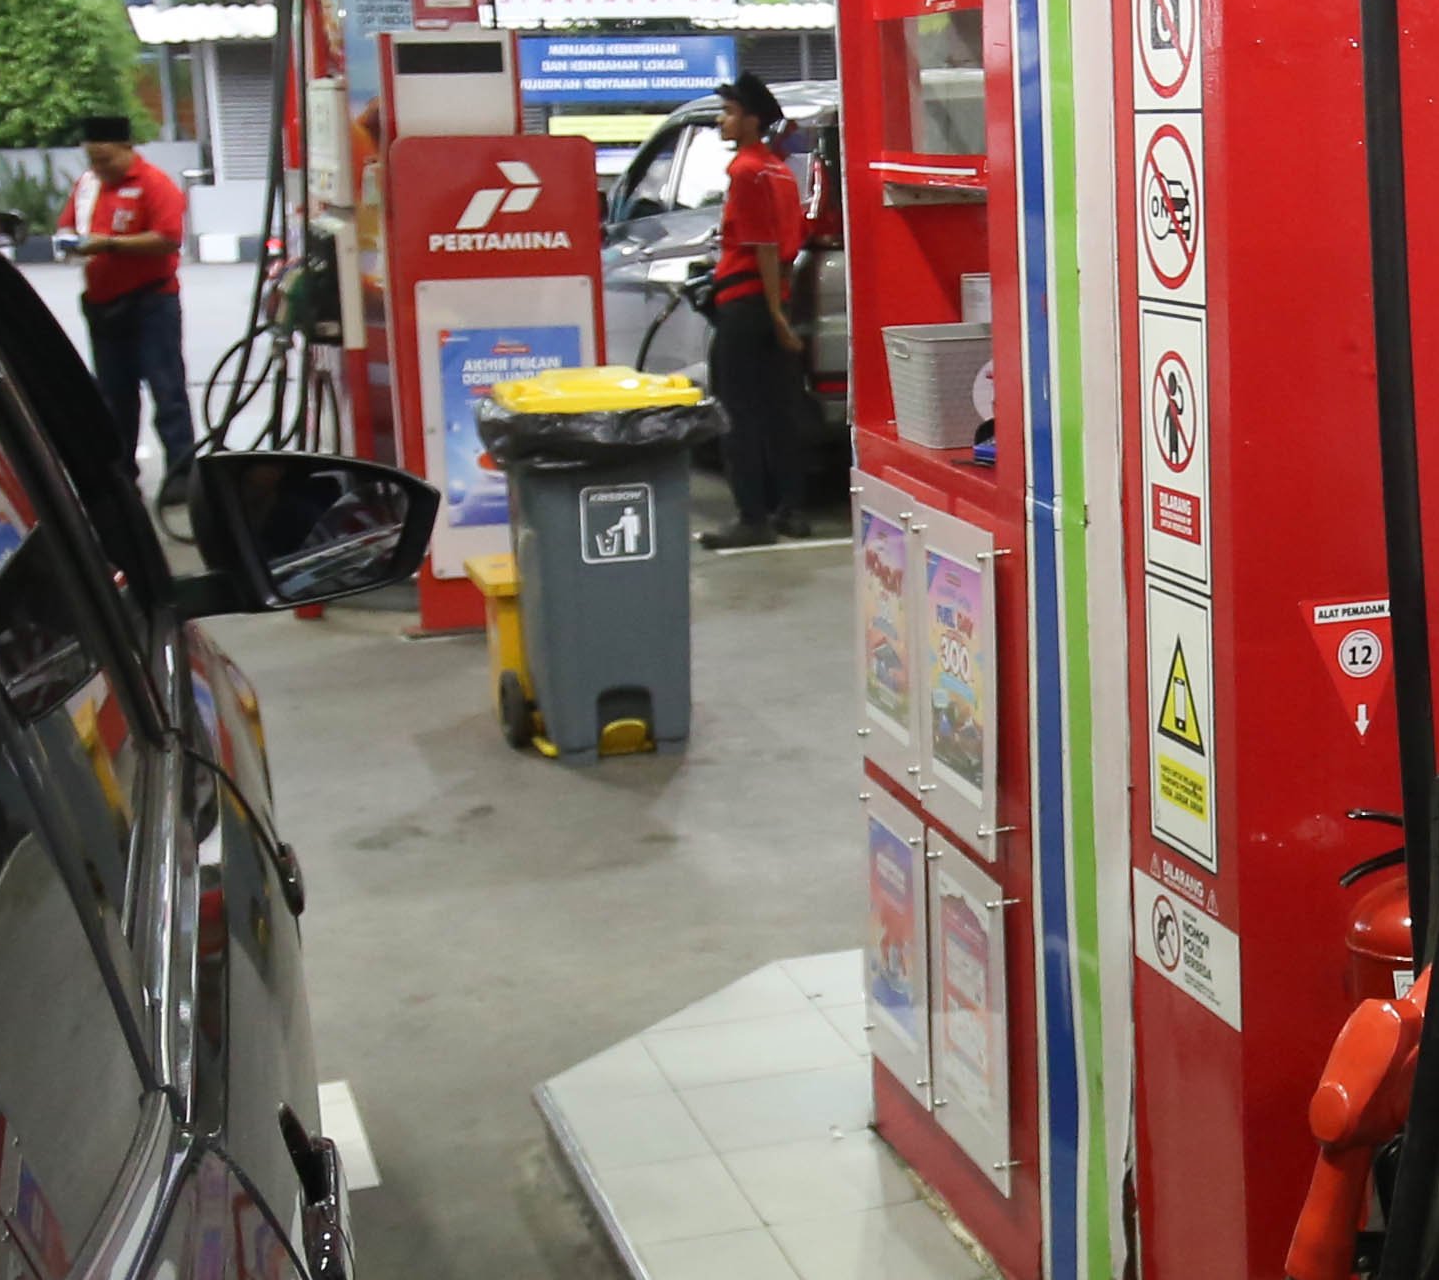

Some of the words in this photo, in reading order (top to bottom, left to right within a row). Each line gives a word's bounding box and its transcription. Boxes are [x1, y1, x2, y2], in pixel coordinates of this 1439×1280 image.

[429, 231, 571, 253] PERTAMINA
[1318, 608, 1339, 620] ALAT
[1341, 604, 1385, 618] PEMADAM
[940, 635, 971, 684] 300
[1348, 644, 1373, 666] 12
[1163, 859, 1205, 898] DILARANG
